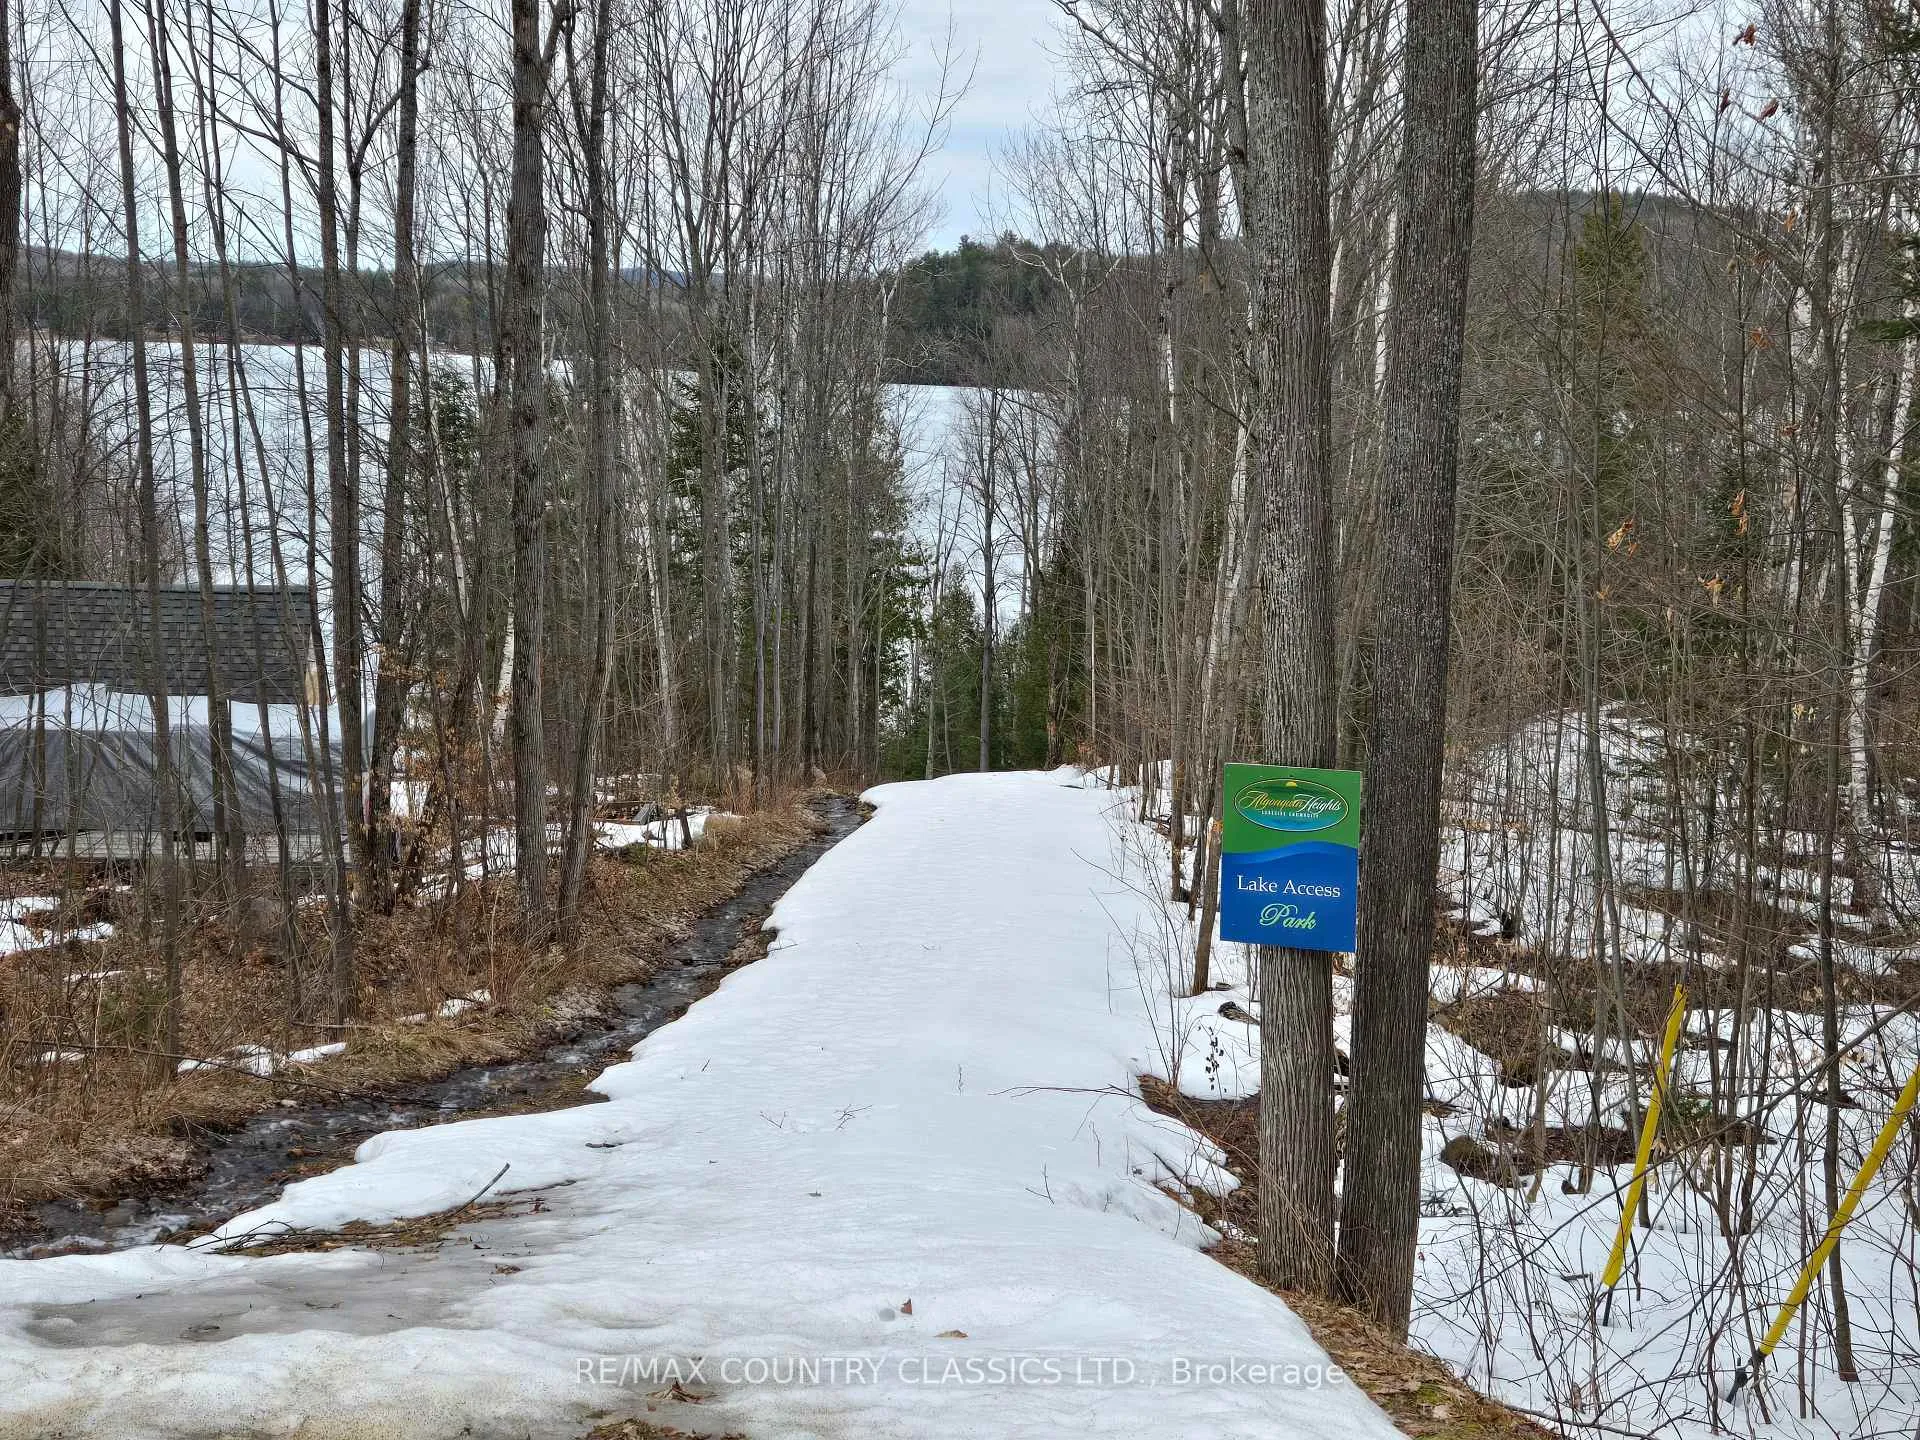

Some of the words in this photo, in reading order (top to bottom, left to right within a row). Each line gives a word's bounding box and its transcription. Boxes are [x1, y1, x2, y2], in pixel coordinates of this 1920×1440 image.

[1240, 791, 1303, 811] Algonquin
[1295, 793, 1342, 815] Heights
[1237, 874, 1278, 893] Lake
[1283, 879, 1341, 898] Access
[1259, 903, 1316, 930] Park
